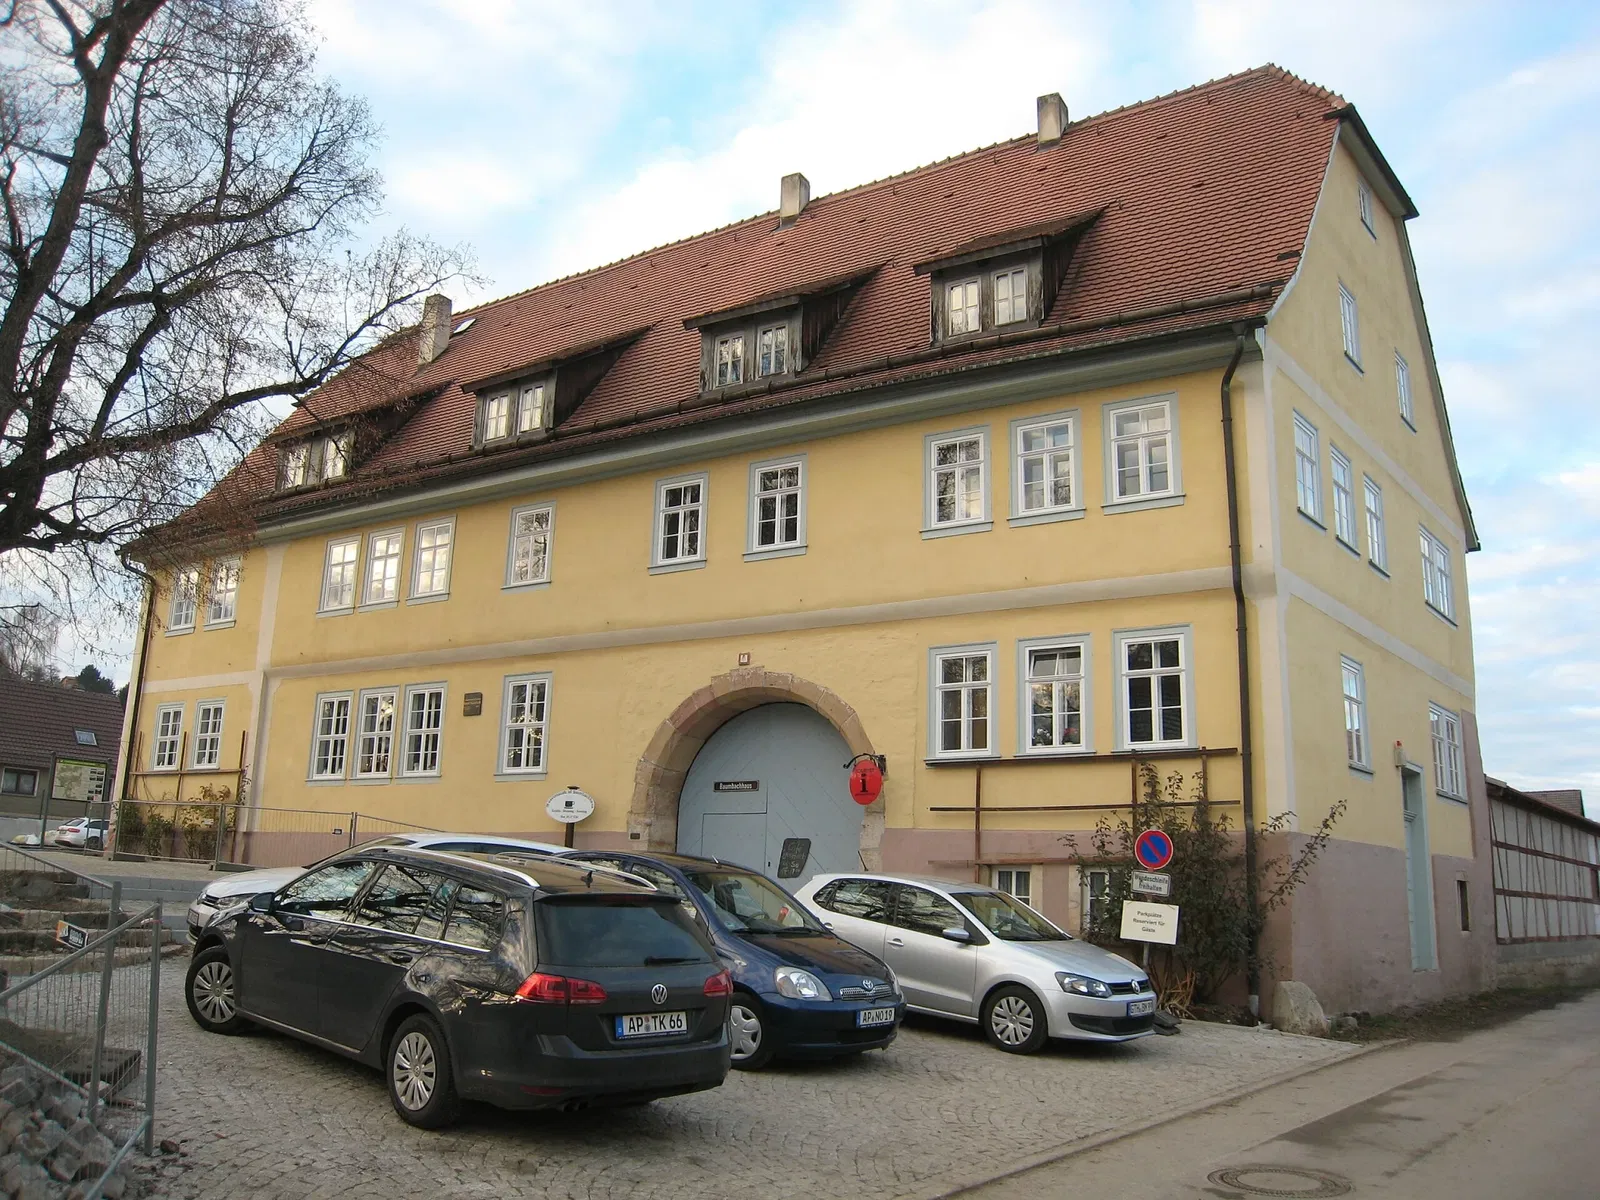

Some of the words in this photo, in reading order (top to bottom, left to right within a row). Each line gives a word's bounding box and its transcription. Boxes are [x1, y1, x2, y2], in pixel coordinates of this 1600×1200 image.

[719, 782, 753, 790] Baumbachhaus
[860, 773, 869, 793] i
[1138, 882, 1163, 892] freihalten
[1137, 910, 1162, 919] Parkplätze
[1132, 917, 1157, 926] Reserviert
[863, 1011, 872, 1023] AP
[628, 1016, 643, 1032] AP
[651, 1014, 667, 1030] TK
[669, 1013, 683, 1029] 66
